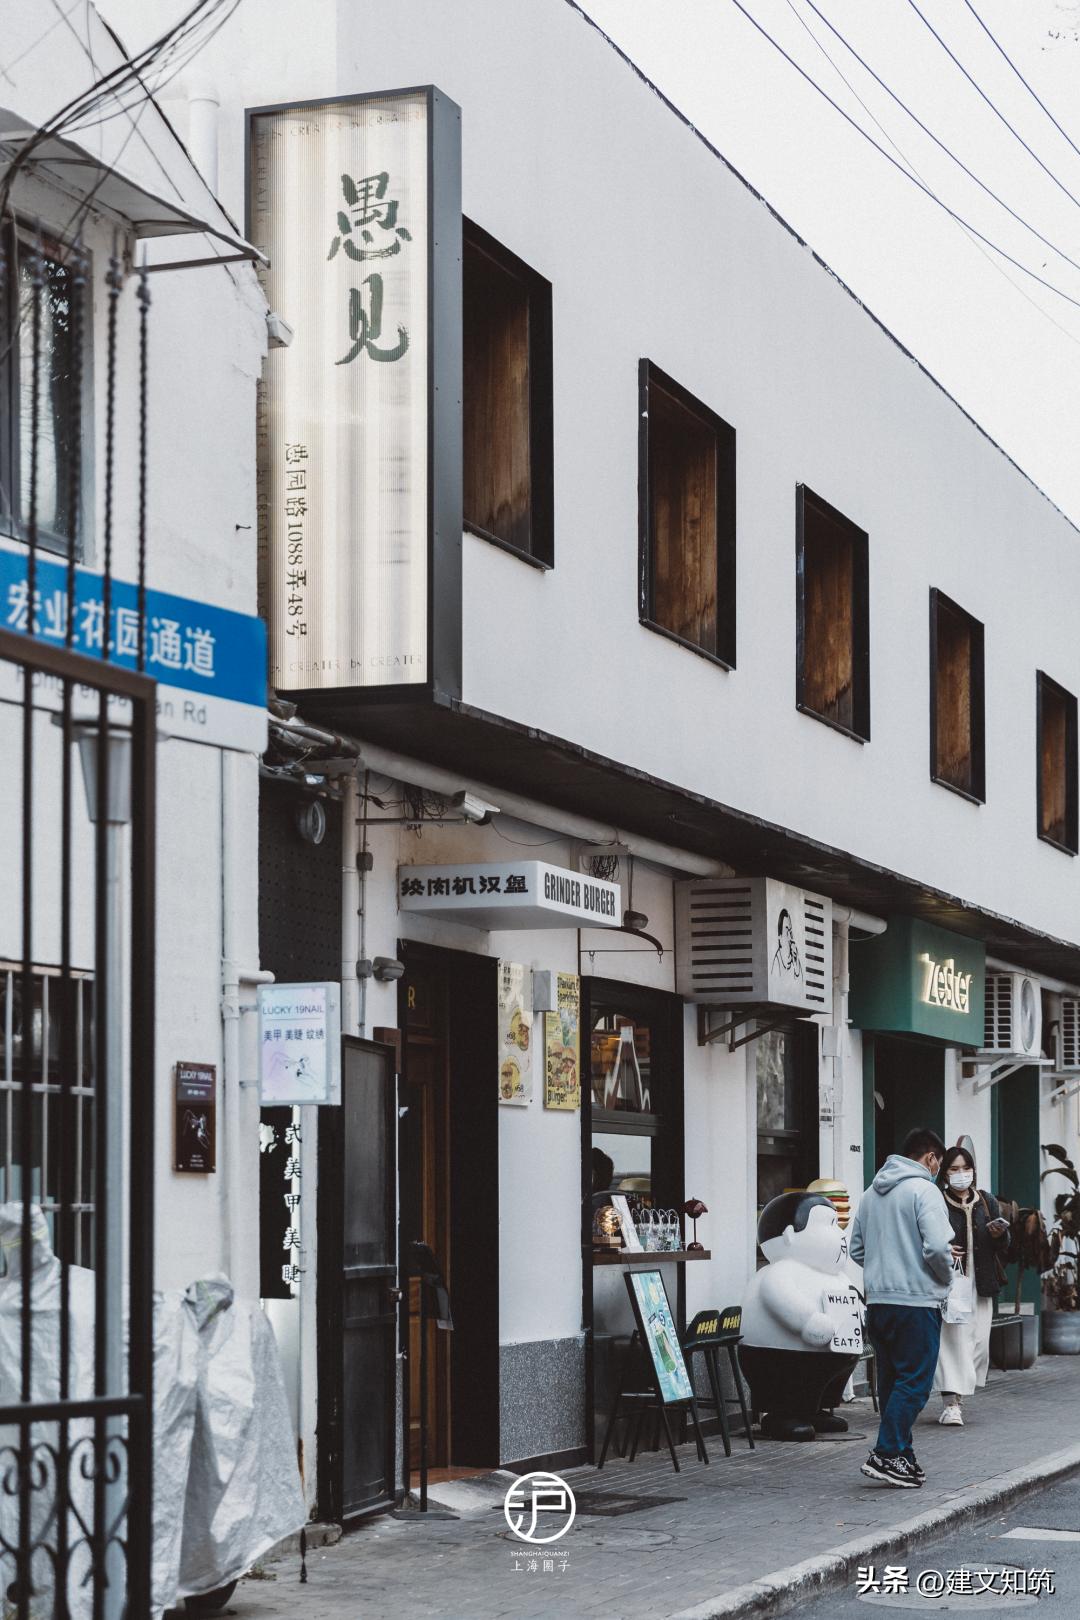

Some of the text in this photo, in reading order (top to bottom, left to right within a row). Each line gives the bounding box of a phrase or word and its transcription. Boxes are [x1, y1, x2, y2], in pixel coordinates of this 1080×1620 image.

[327, 171, 413, 366] 愚见
[7, 579, 216, 678] 宏业花园通道
[184, 701, 207, 725] Rd
[401, 874, 529, 897] 绞肉机汉堡
[544, 872, 616, 917] GRINDER BURGER
[262, 1005, 324, 1015] LUCKY 19NAIL
[263, 1030, 282, 1042] 美甲
[827, 1294, 856, 1305] WHAT
[833, 1337, 861, 1349] EAT?
